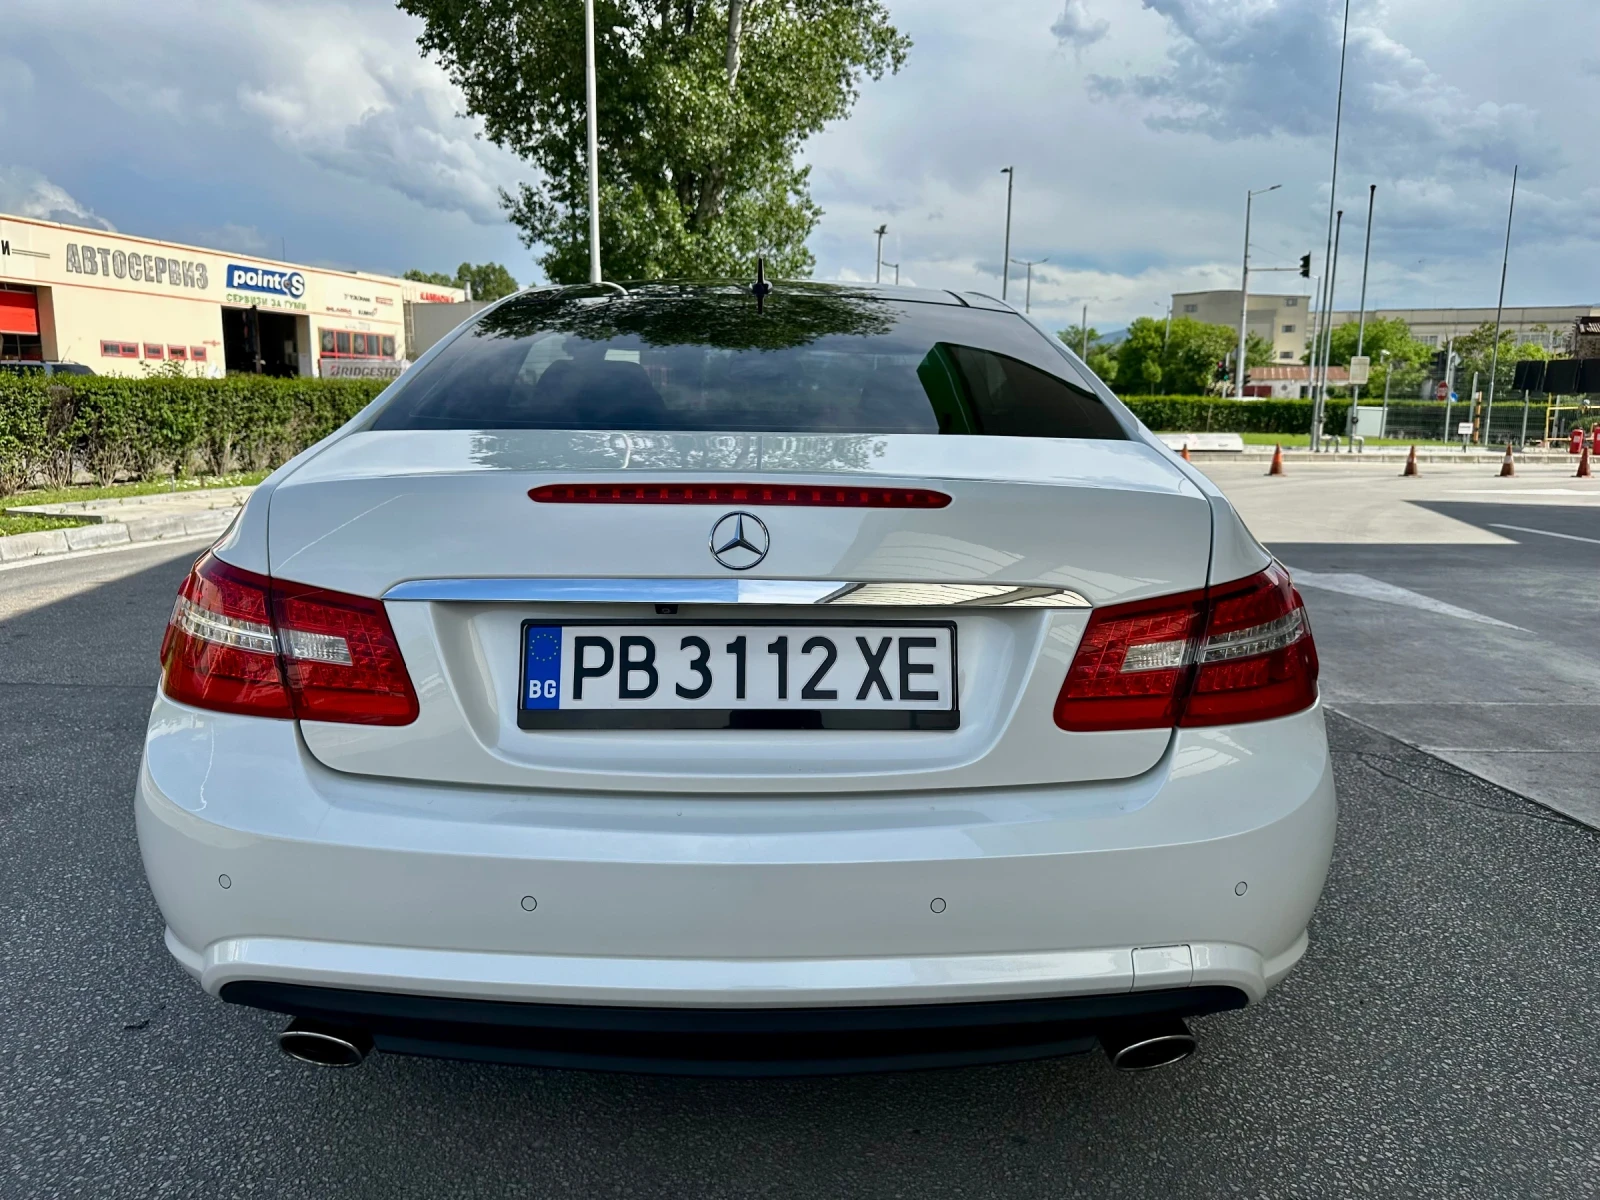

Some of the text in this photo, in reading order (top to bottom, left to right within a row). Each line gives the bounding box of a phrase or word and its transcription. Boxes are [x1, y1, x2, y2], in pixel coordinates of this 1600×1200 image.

[66, 242, 209, 290] АВТОСЕРВИЗ
[233, 270, 281, 290] point
[226, 293, 268, 306] СЕРВИЗИ
[573, 635, 939, 700] PB 3112 XE
[529, 680, 557, 699] BG
